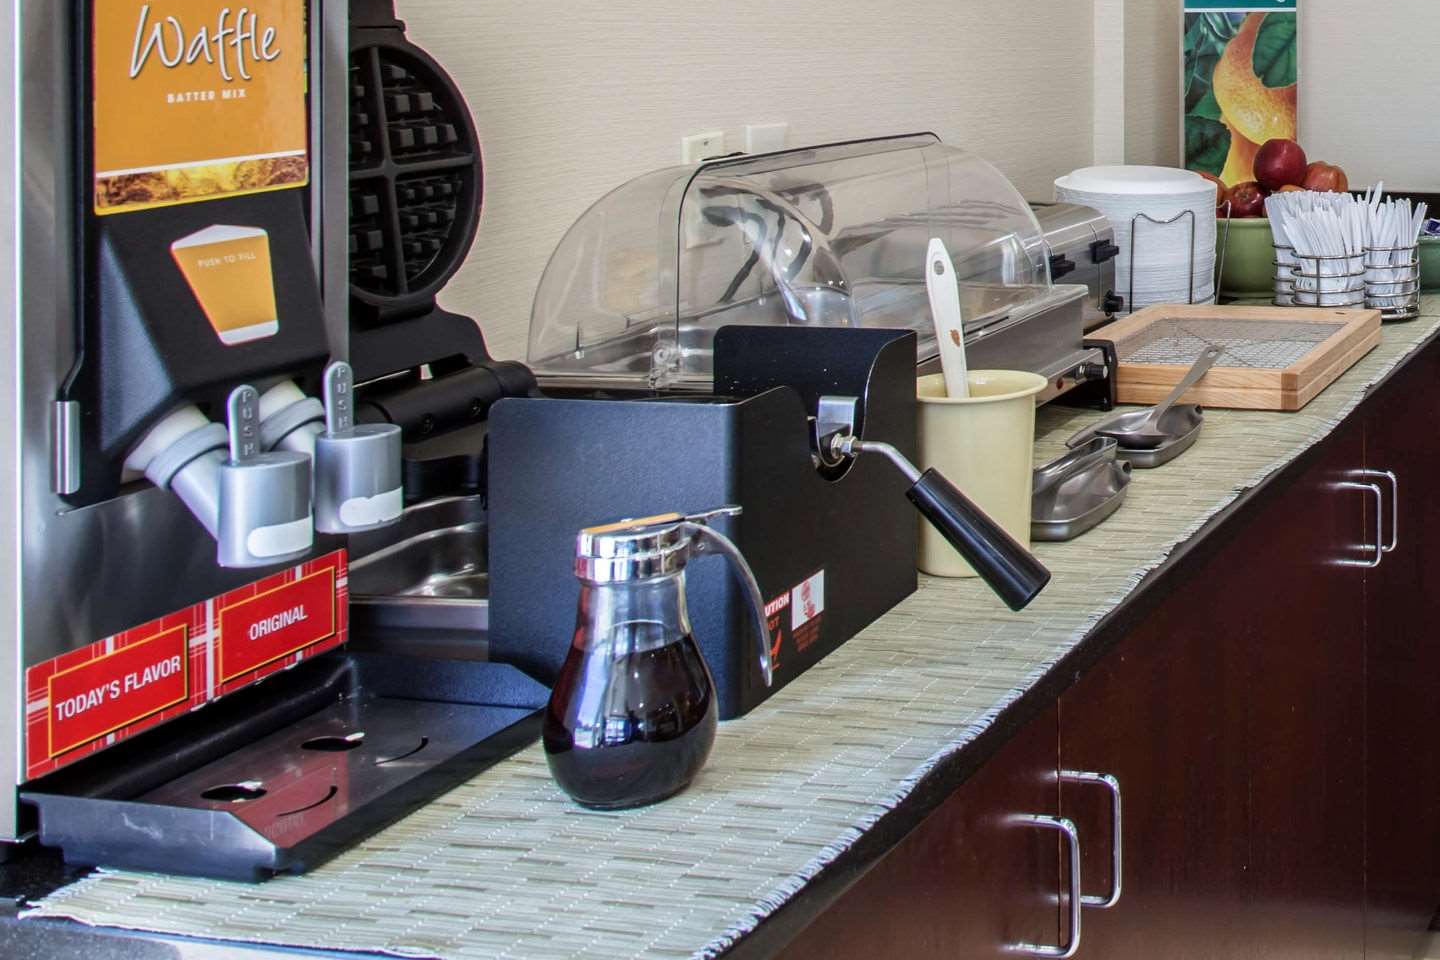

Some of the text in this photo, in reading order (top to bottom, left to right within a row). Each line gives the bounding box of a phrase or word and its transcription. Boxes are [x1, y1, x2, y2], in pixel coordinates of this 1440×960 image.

[129, 5, 282, 81] Waffle
[167, 89, 246, 104] BATTER MIX
[248, 605, 307, 641] ORIGINAL
[56, 655, 181, 721] TODAY'S FLAVOR
